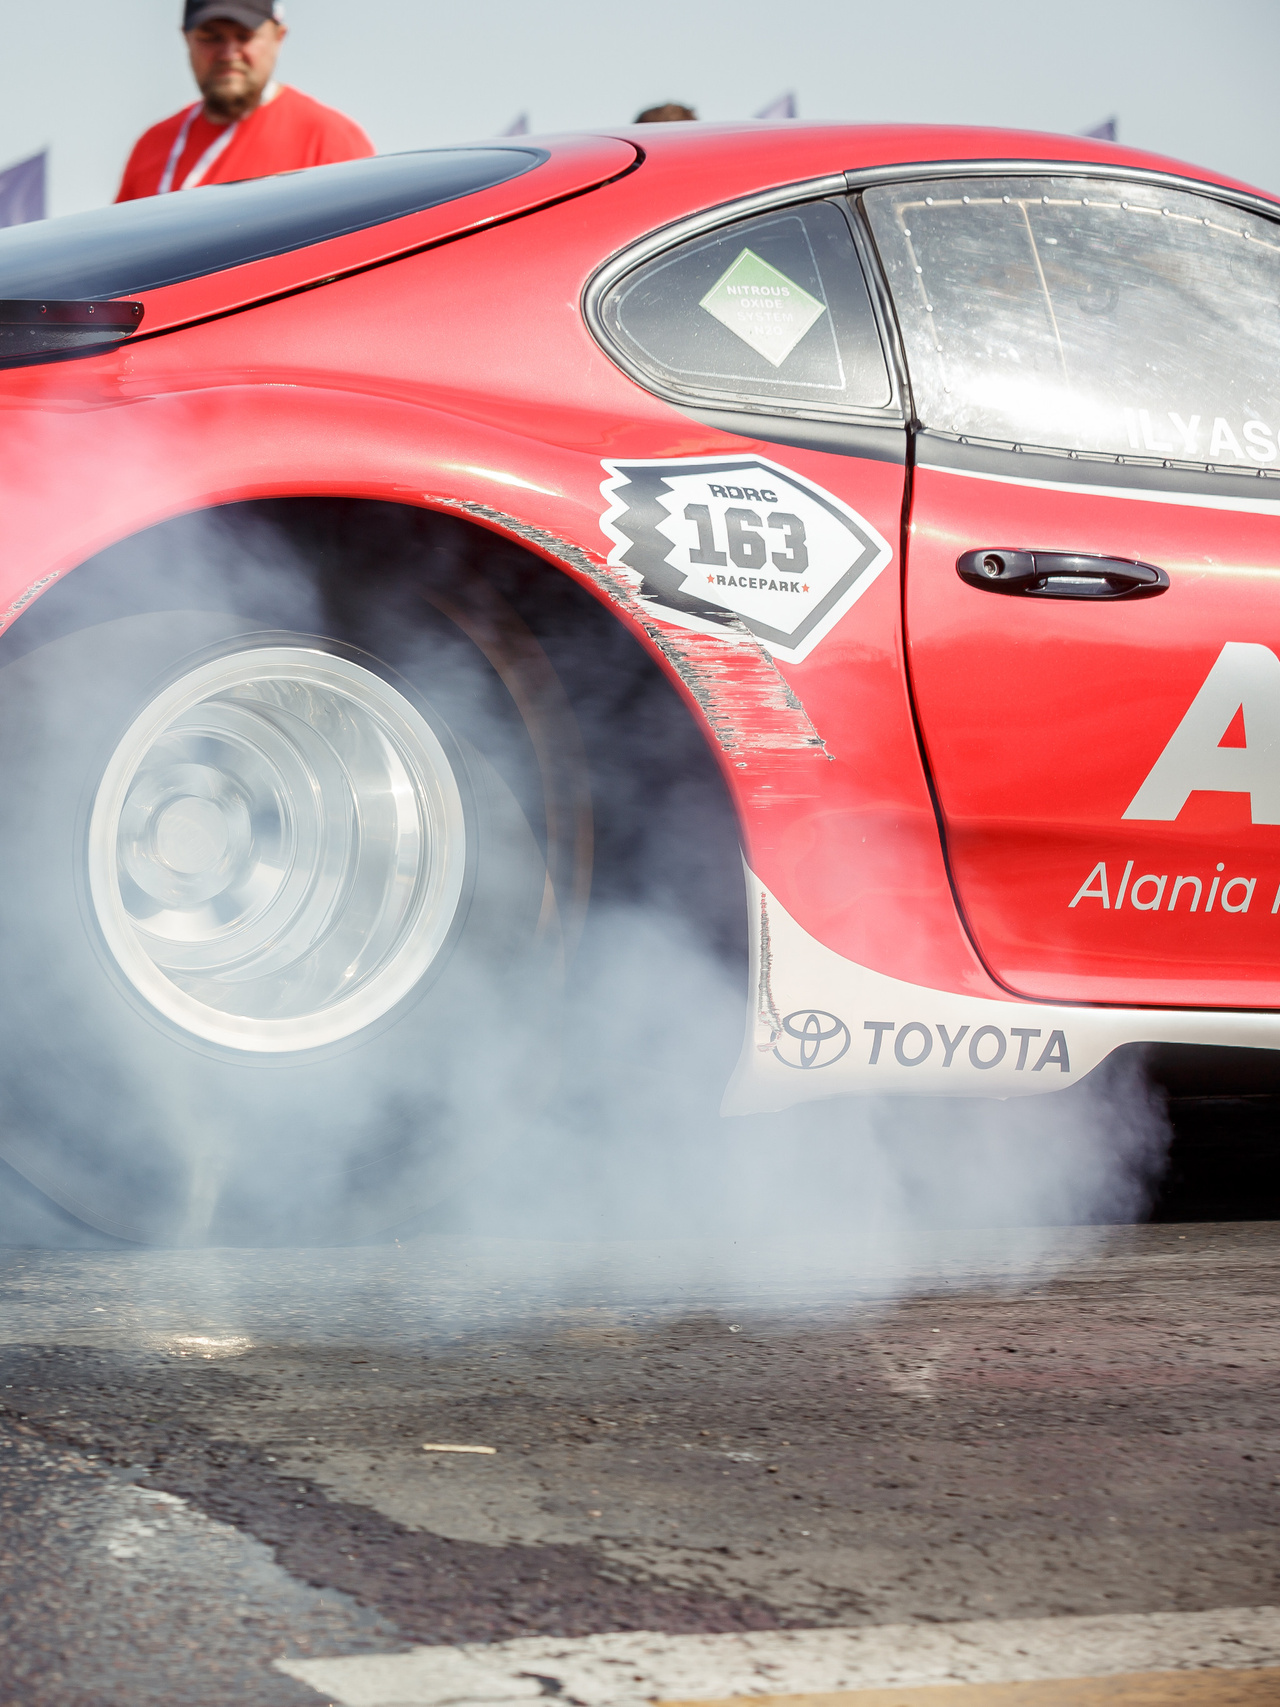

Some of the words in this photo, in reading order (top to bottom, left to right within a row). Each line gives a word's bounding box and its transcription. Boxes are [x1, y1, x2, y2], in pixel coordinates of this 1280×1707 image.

[726, 285, 790, 297] NITROUS
[740, 298, 784, 309] OXIDE
[737, 311, 793, 322] SYSTEM
[754, 325, 783, 336] N2O
[1123, 407, 1280, 462] ILYAS
[707, 483, 778, 503] RDRC
[683, 503, 809, 574] 163
[716, 574, 801, 593] RACEPARK
[1068, 860, 1257, 913] Alania
[863, 1020, 1070, 1073] TOYOTA
